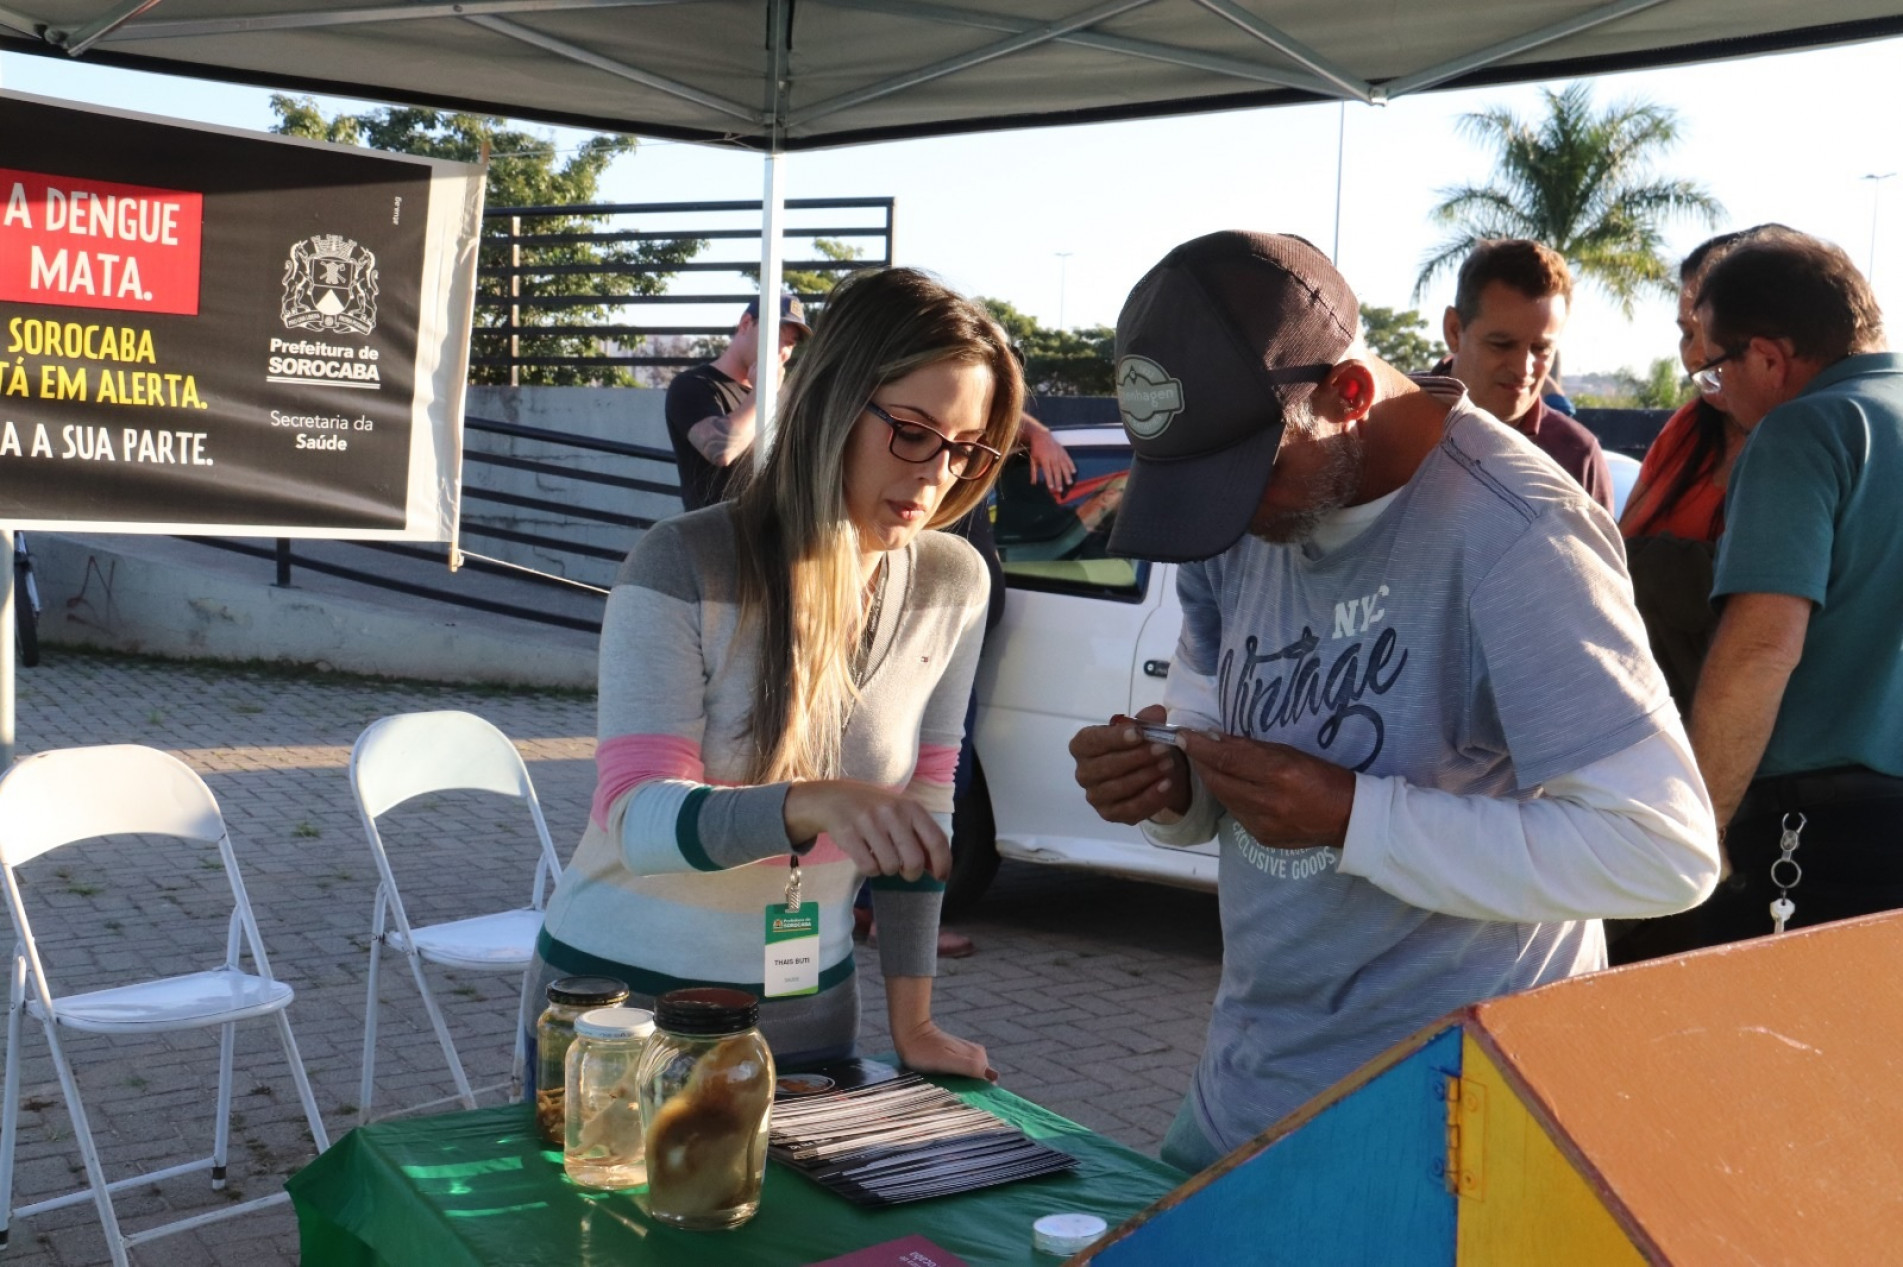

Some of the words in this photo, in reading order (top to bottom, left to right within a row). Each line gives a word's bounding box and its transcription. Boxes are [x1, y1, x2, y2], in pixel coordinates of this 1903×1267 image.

[4, 182, 32, 229] A
[46, 187, 180, 246] DENGUE
[30, 245, 153, 301] MATA.
[8, 317, 156, 364] SOROCABA
[271, 338, 354, 359] Prefeitura
[358, 346, 379, 360] de
[40, 365, 87, 401] EM
[96, 369, 208, 410] ALERTA.
[268, 357, 380, 381] SOROCABA
[270, 410, 349, 430] Secretaria
[353, 415, 374, 431] da
[296, 433, 348, 451] Saúde
[31, 423, 53, 458] A
[62, 424, 115, 461] SUA
[124, 428, 213, 466] PARTE.
[1332, 585, 1389, 639] NYC
[1218, 626, 1408, 773] Vintage
[1233, 821, 1287, 879] EXCLUSIVE
[1292, 846, 1336, 880] GOODS
